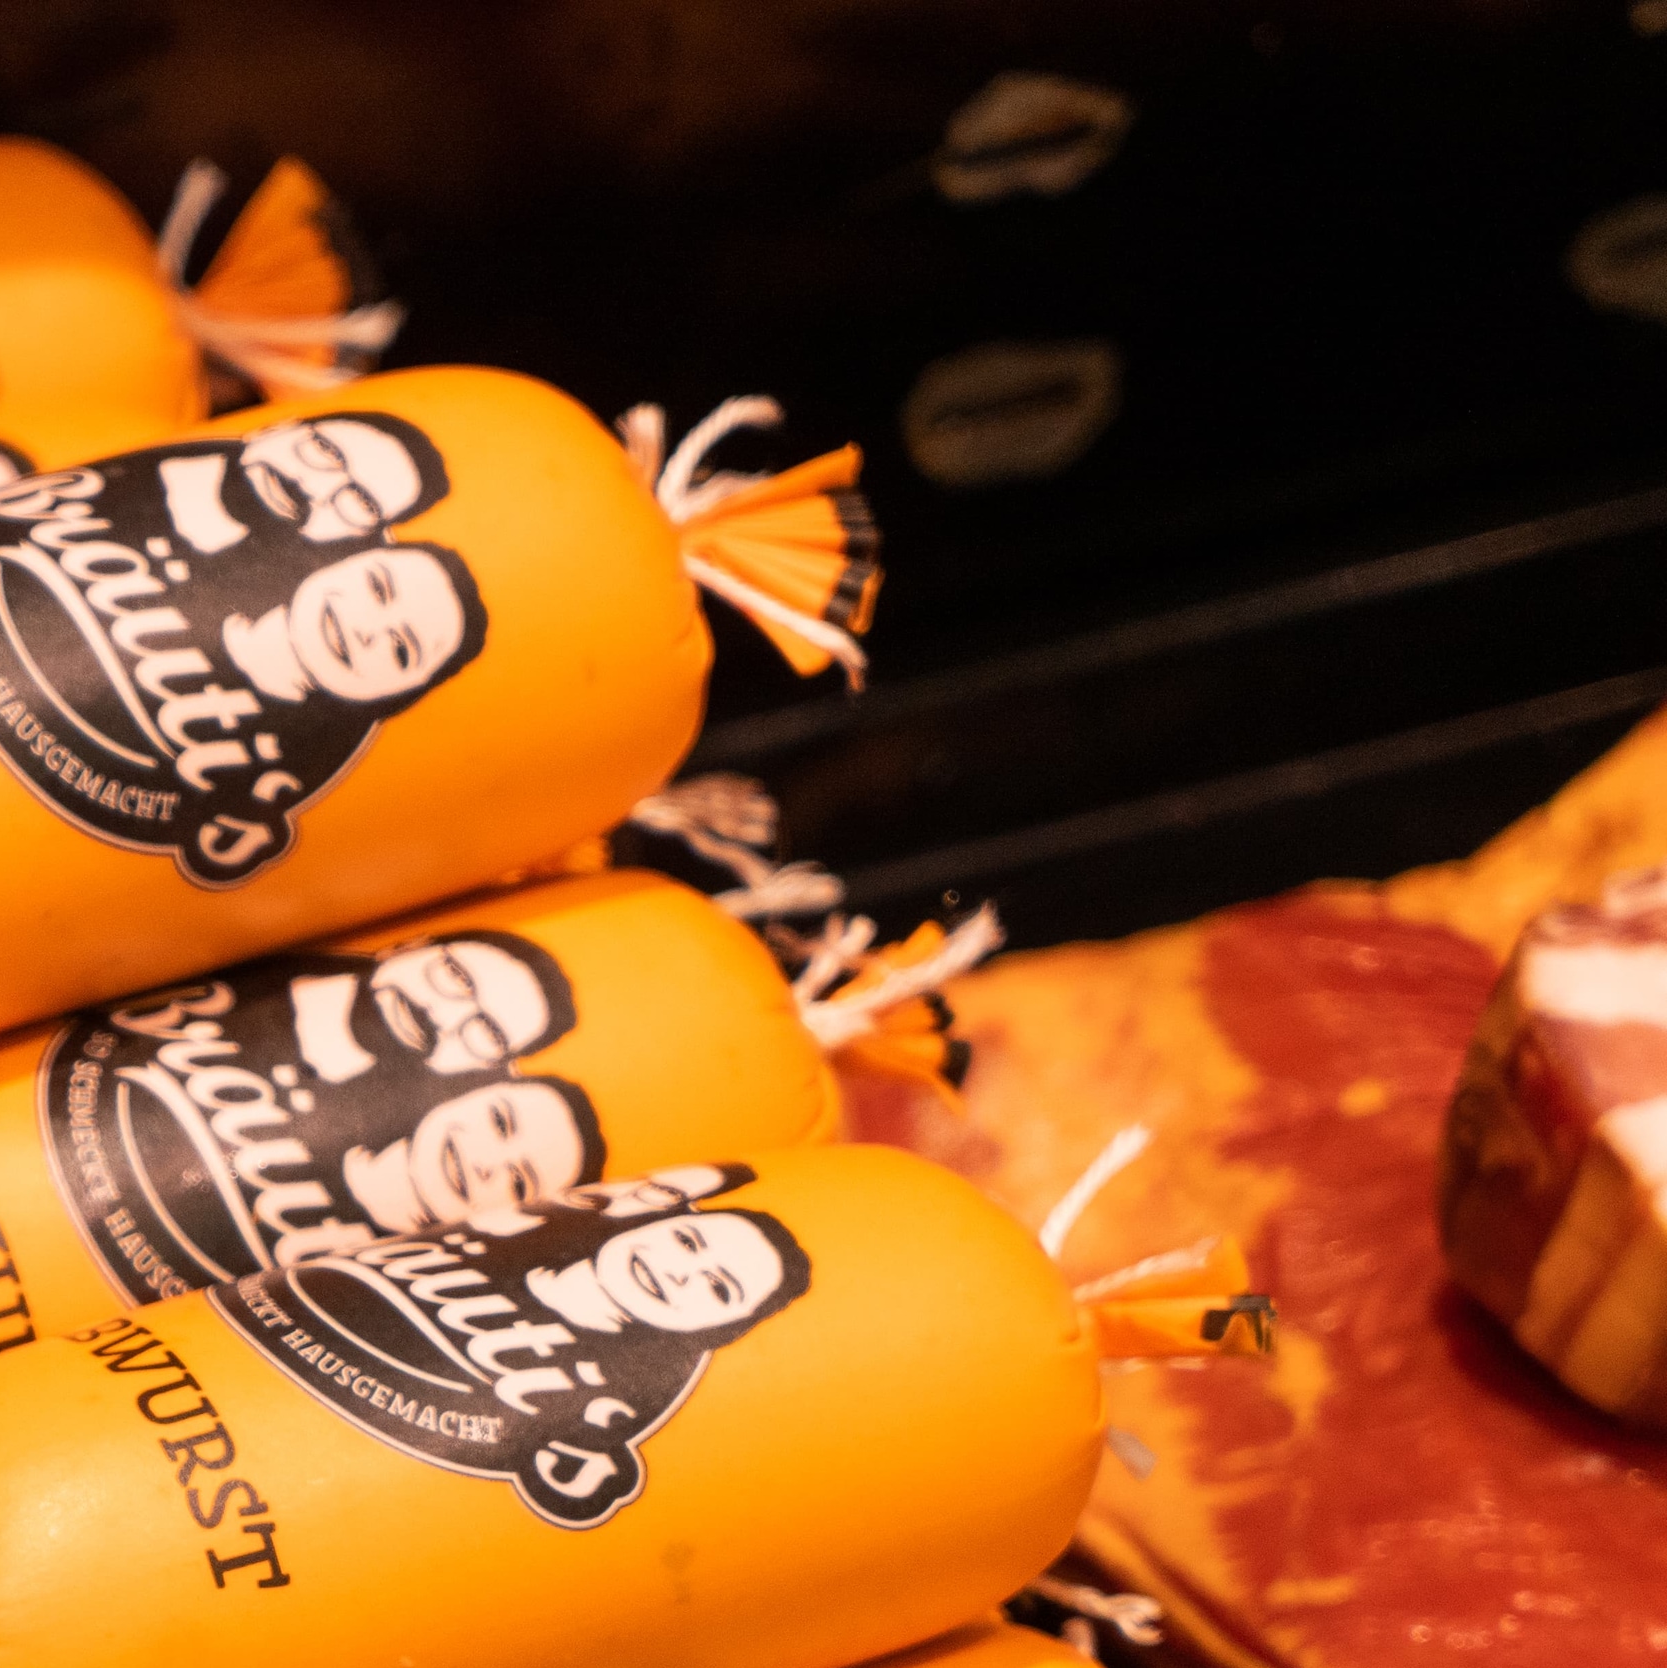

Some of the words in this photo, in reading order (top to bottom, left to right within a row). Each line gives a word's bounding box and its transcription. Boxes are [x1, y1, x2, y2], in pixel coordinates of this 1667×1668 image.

[111, 981, 378, 1269] Bräut
[281, 1327, 504, 1445] HAUSGEMACHT
[356, 1232, 637, 1498] äuti's
